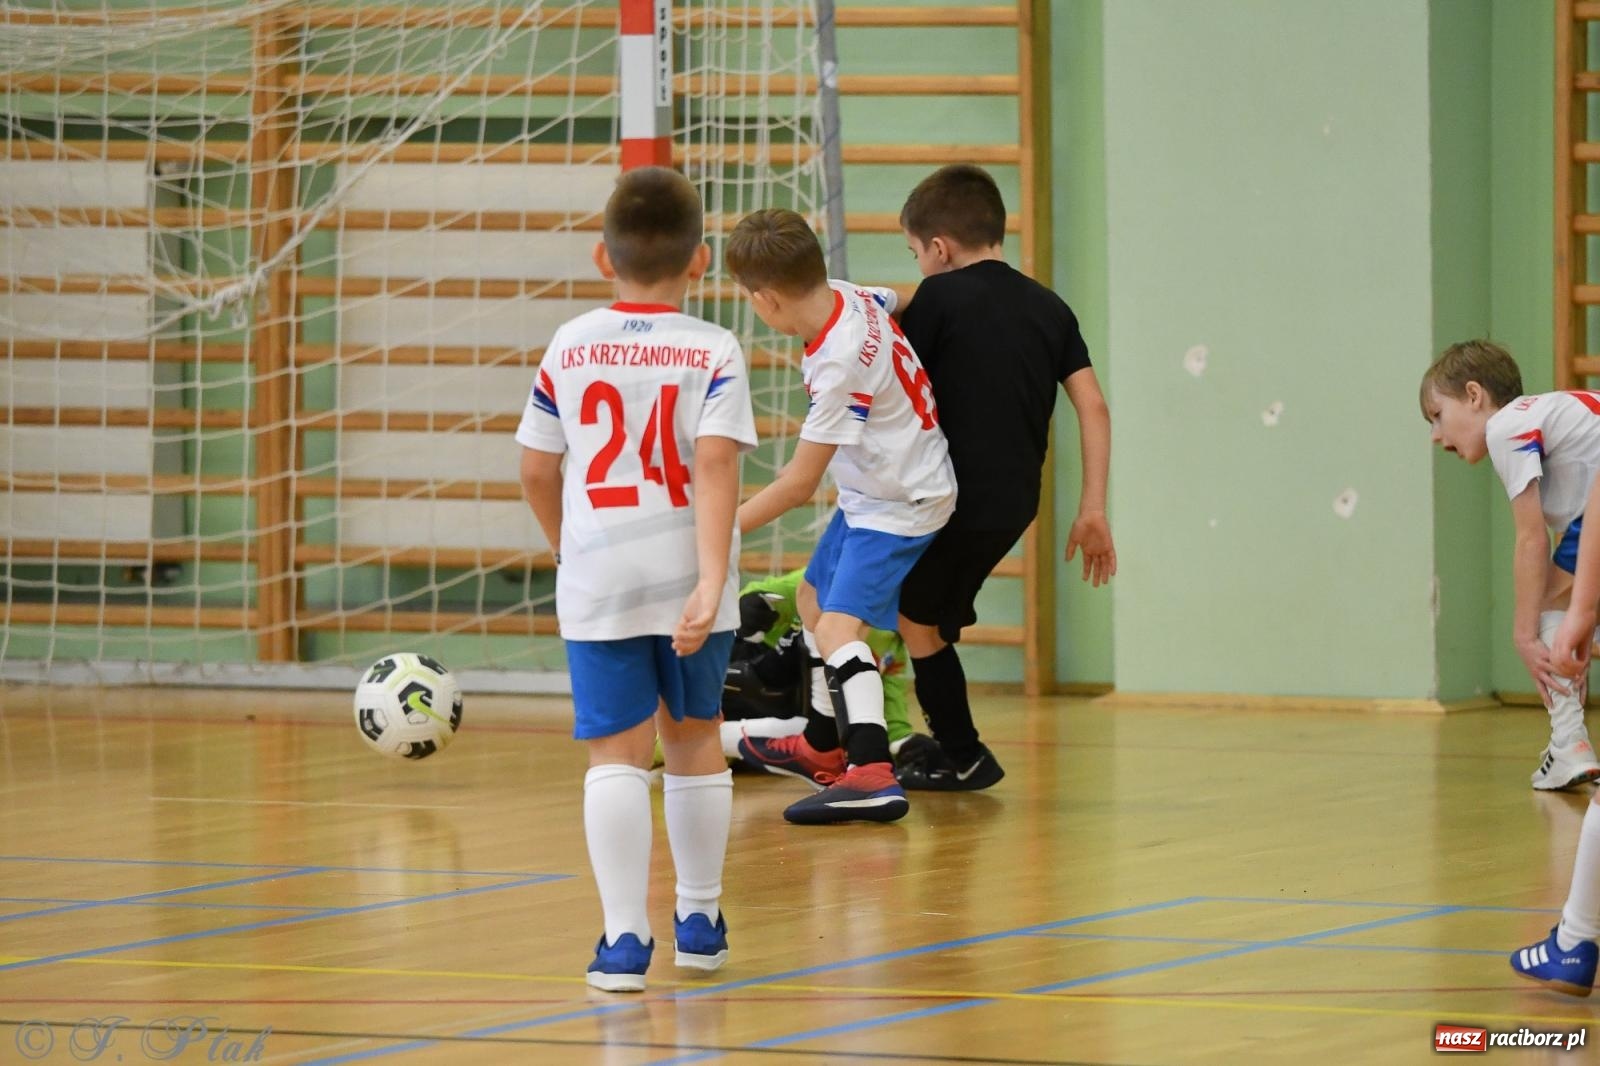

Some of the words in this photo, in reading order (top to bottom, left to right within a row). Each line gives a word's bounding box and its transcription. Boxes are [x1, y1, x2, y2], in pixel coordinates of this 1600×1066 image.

[622, 319, 652, 332] 1920
[561, 346, 585, 369] LKS
[589, 342, 711, 370] KRZYŻANOWICE
[580, 380, 691, 509] 24
